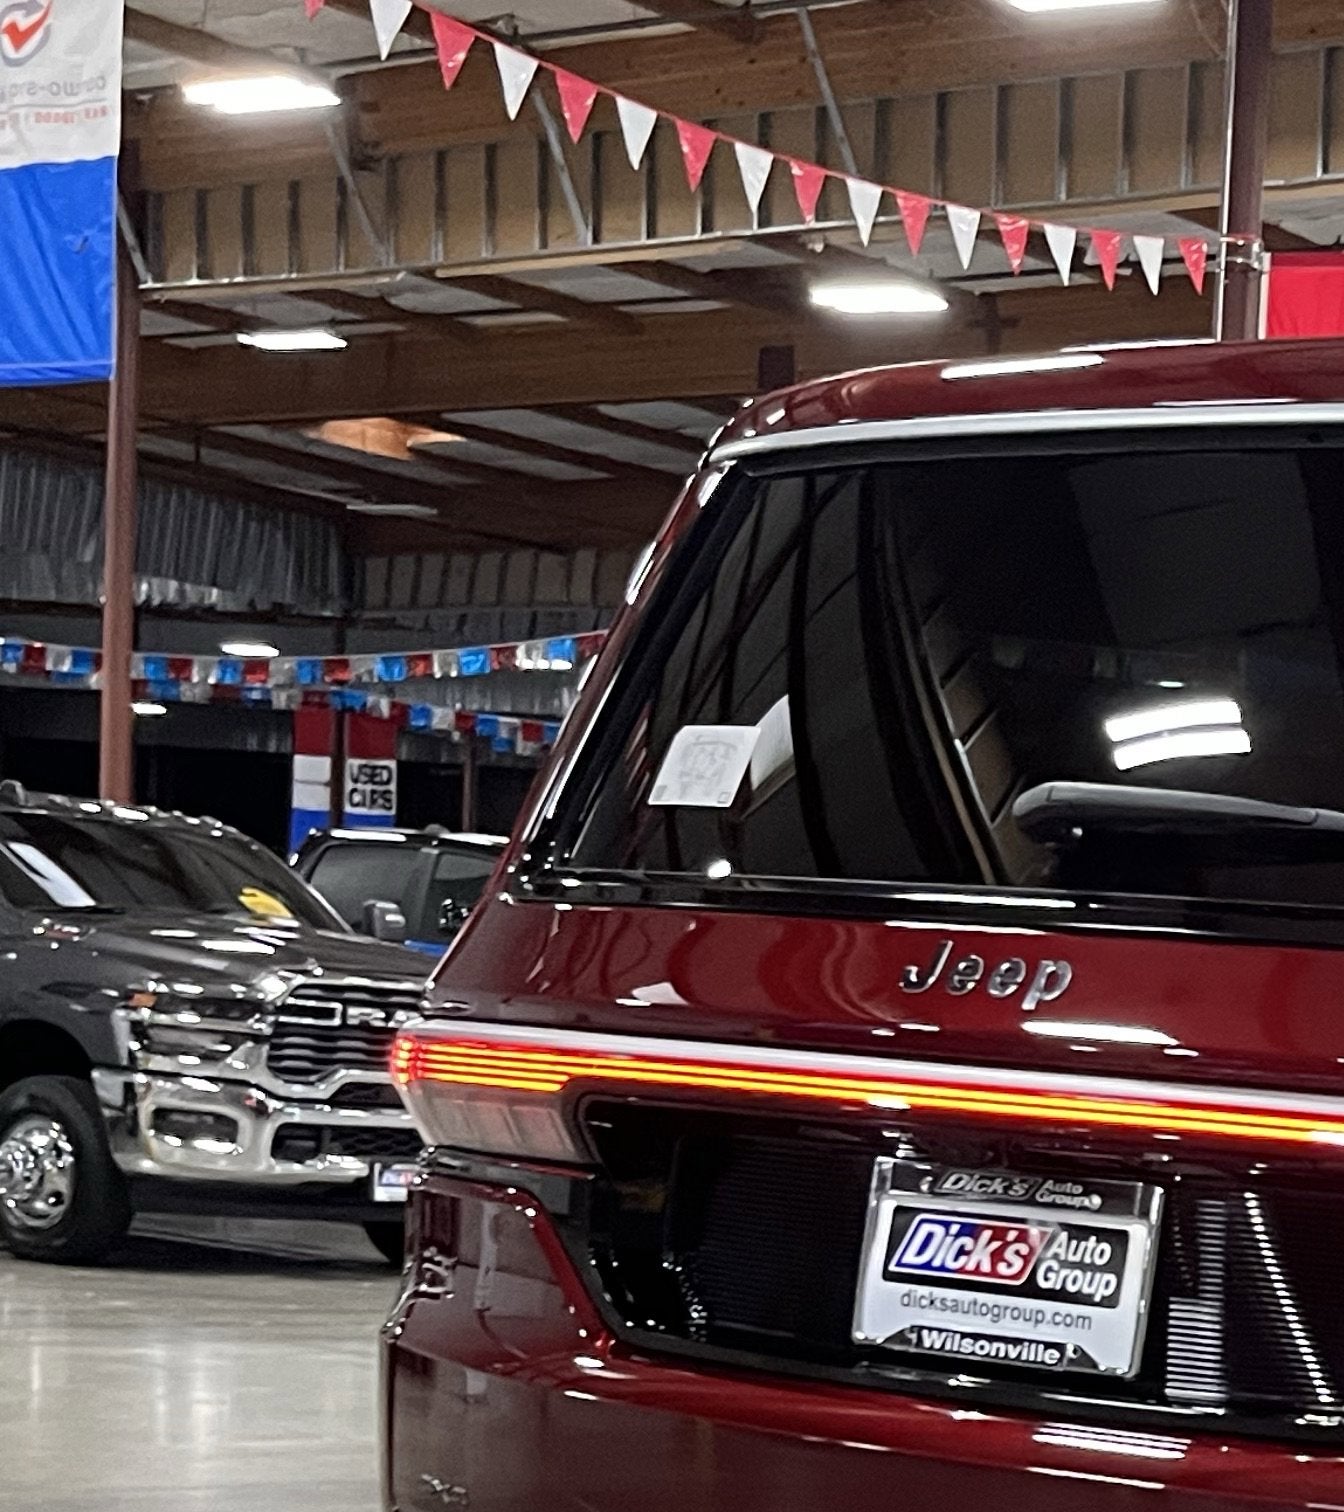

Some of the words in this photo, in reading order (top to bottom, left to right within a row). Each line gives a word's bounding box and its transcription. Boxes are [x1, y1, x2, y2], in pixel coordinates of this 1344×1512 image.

[349, 762, 393, 786] USED
[898, 940, 1073, 1011] Jeep
[942, 1172, 1029, 1197] Dick's
[1044, 1179, 1084, 1195] Auto
[901, 1222, 1030, 1278] Dick's
[1045, 1230, 1112, 1266] Auto
[1036, 1259, 1118, 1302] Group
[900, 1290, 1094, 1330] dicksautogroup.com
[920, 1329, 1062, 1365] Wilsonville
